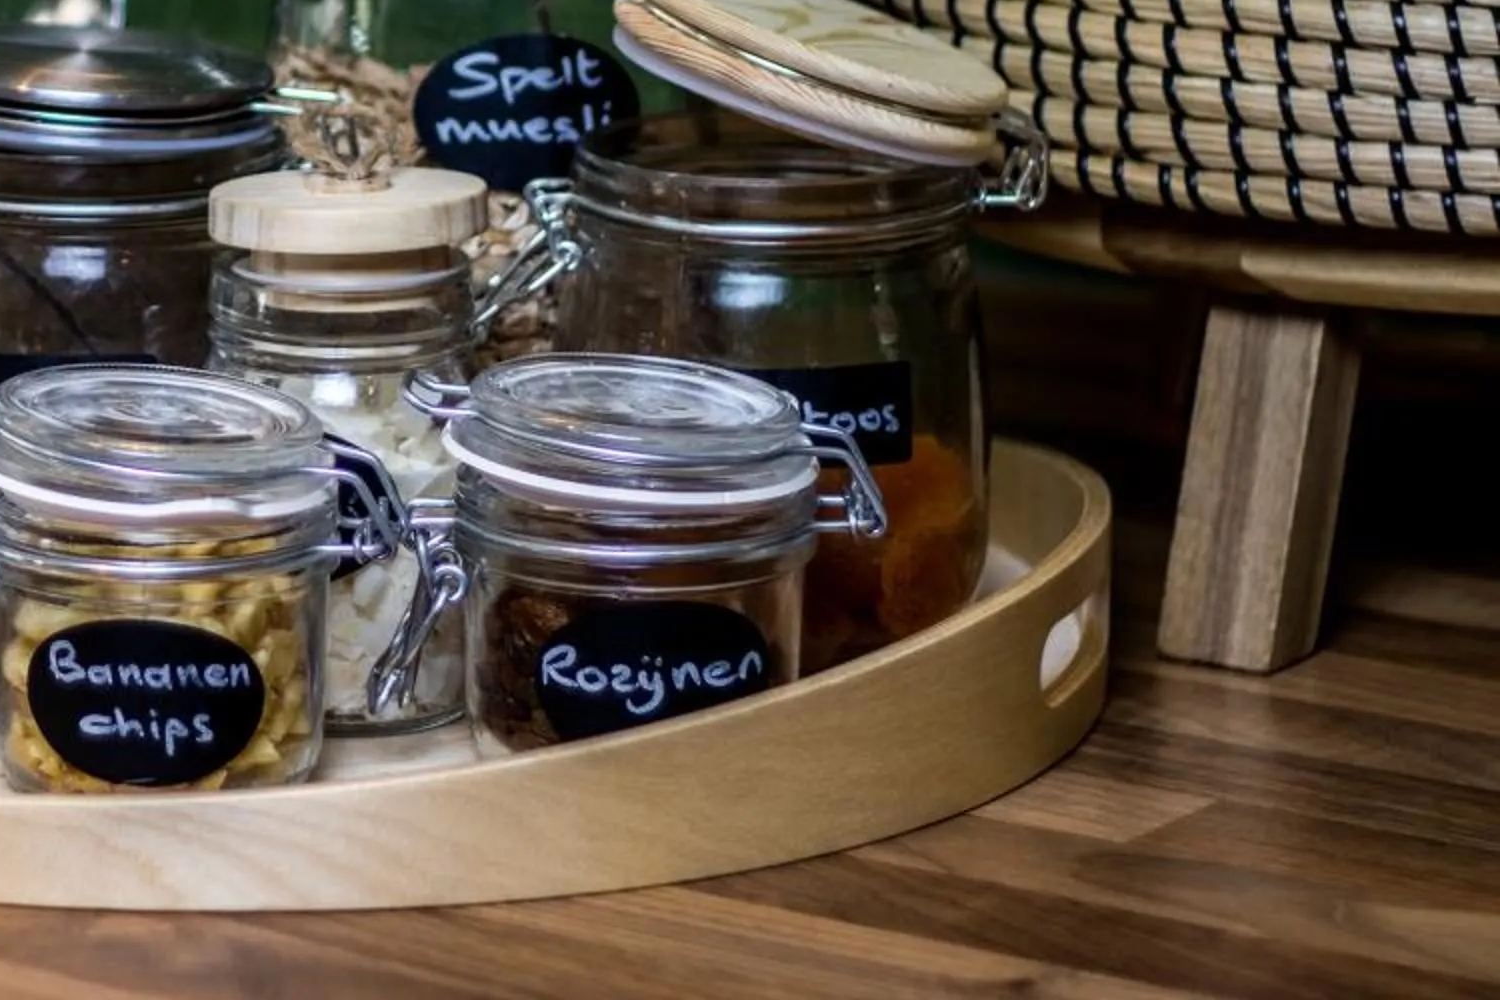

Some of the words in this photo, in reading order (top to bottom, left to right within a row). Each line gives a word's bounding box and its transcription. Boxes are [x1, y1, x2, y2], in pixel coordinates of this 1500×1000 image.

[448, 49, 602, 104] Spelt
[436, 101, 612, 143] muesli
[49, 639, 251, 691] Bananen
[79, 705, 214, 757] chips
